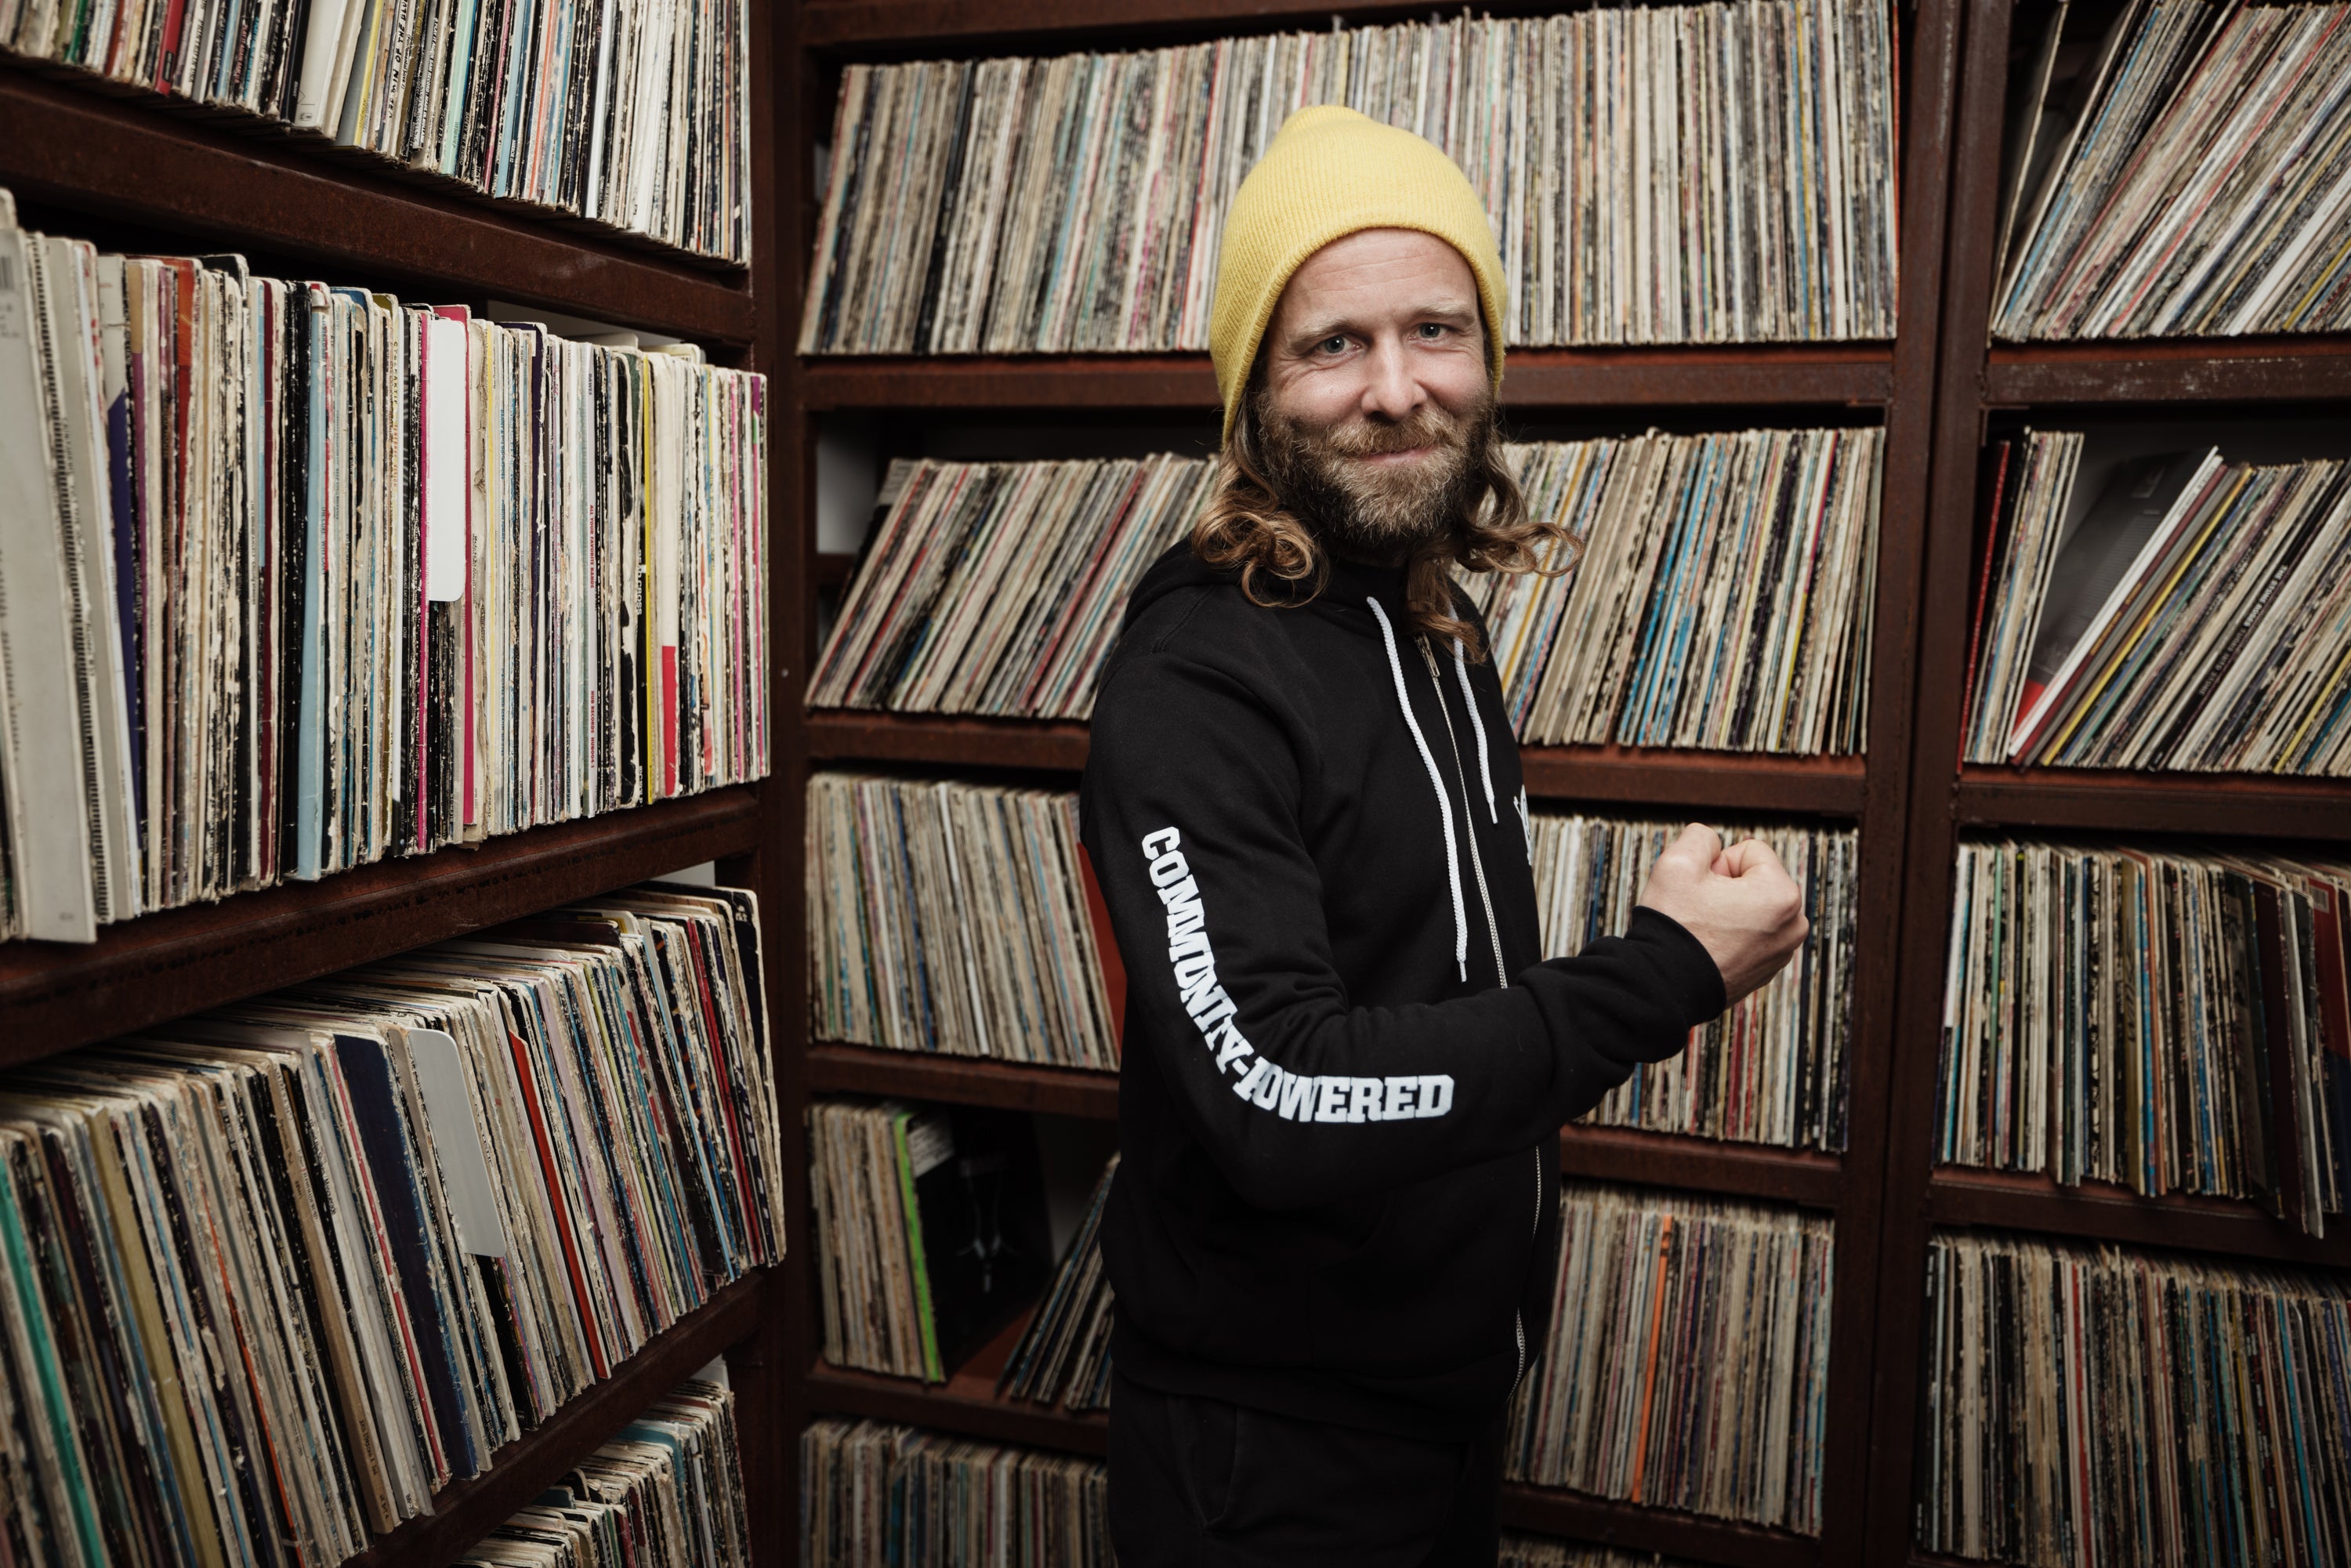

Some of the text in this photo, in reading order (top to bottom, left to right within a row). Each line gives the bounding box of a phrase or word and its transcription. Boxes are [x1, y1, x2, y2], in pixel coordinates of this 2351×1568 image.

[394, 21, 406, 43] THE
[393, 46, 403, 63] OF
[418, 117, 427, 145] HOLLAND
[2198, 562, 2288, 697] THE STONE ROSES TURNS INTO STONE
